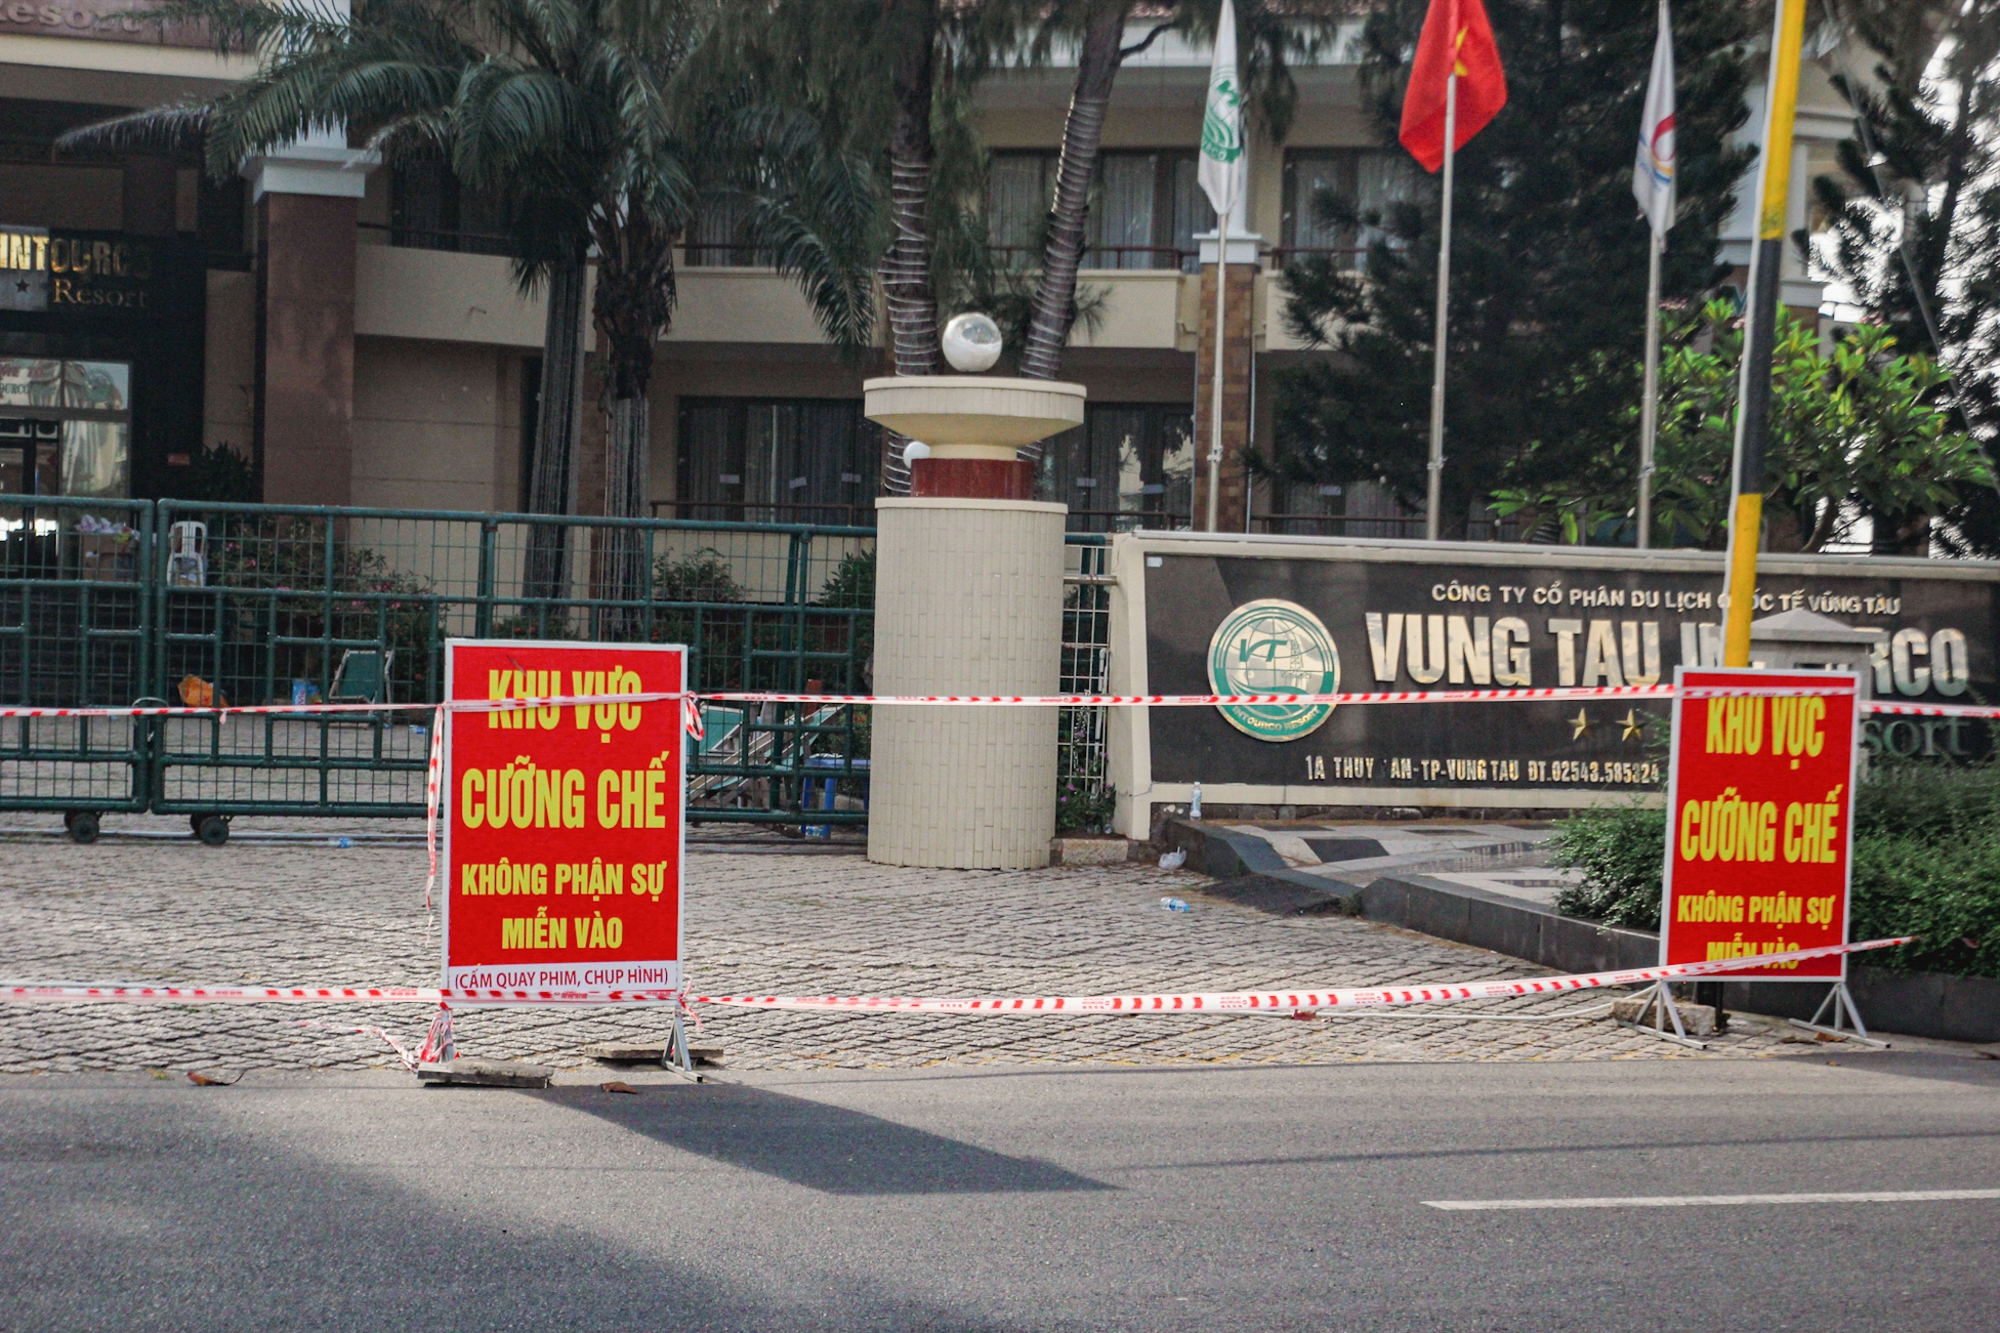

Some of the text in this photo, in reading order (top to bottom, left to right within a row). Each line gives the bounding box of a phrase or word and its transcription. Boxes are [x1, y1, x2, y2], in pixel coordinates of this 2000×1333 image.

[0, 0, 142, 33] esot
[54, 279, 148, 308] Resort
[1432, 580, 1491, 603] CÔNG
[1499, 586, 1526, 604] TY
[1665, 591, 1712, 613] LỊCH
[1778, 588, 1805, 613] TẾ
[1808, 590, 1862, 614] VŨNG
[1863, 592, 1901, 615] TÀU
[1365, 612, 1532, 687] VUNG
[1548, 618, 1661, 688] TAU
[489, 665, 642, 743] KHU VỰC
[1231, 705, 1283, 731] INTOURCO
[1706, 695, 1825, 770] KHU VỰC
[1861, 716, 1972, 758] sort
[1305, 755, 1326, 780] 1A
[1333, 757, 1374, 779] THUY
[1490, 760, 1520, 782] TAU
[461, 751, 670, 829] CƯỠNG CHẾ
[1681, 784, 1843, 863] CƯỠNG CHẾ
[462, 857, 667, 902] KHÔNG PHẬN SỰ
[502, 906, 623, 949] MIỄN VÀO
[1677, 890, 1836, 930] KHÔNG PHẬN SỰ
[454, 967, 668, 990] (CẤM QUAY PHIM, CHỤP HÌNH)
